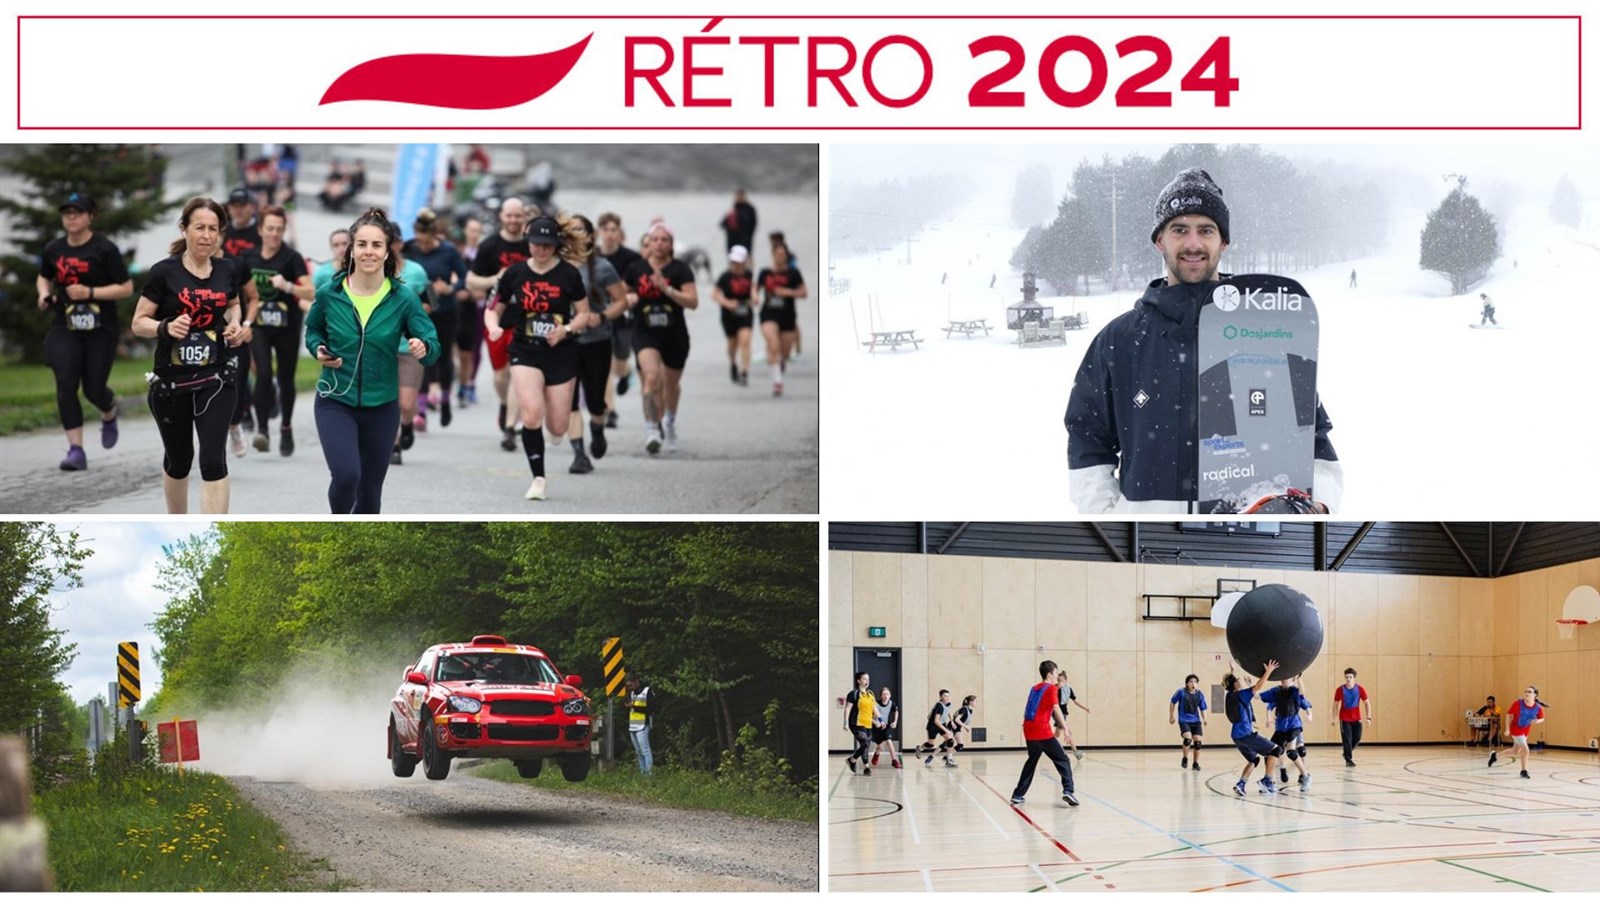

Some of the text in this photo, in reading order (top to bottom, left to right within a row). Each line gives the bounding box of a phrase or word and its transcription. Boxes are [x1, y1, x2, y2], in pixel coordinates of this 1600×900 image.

[1244, 286, 1302, 311] Kalia
[179, 345, 210, 360] 1054
[1203, 463, 1255, 481] radical
